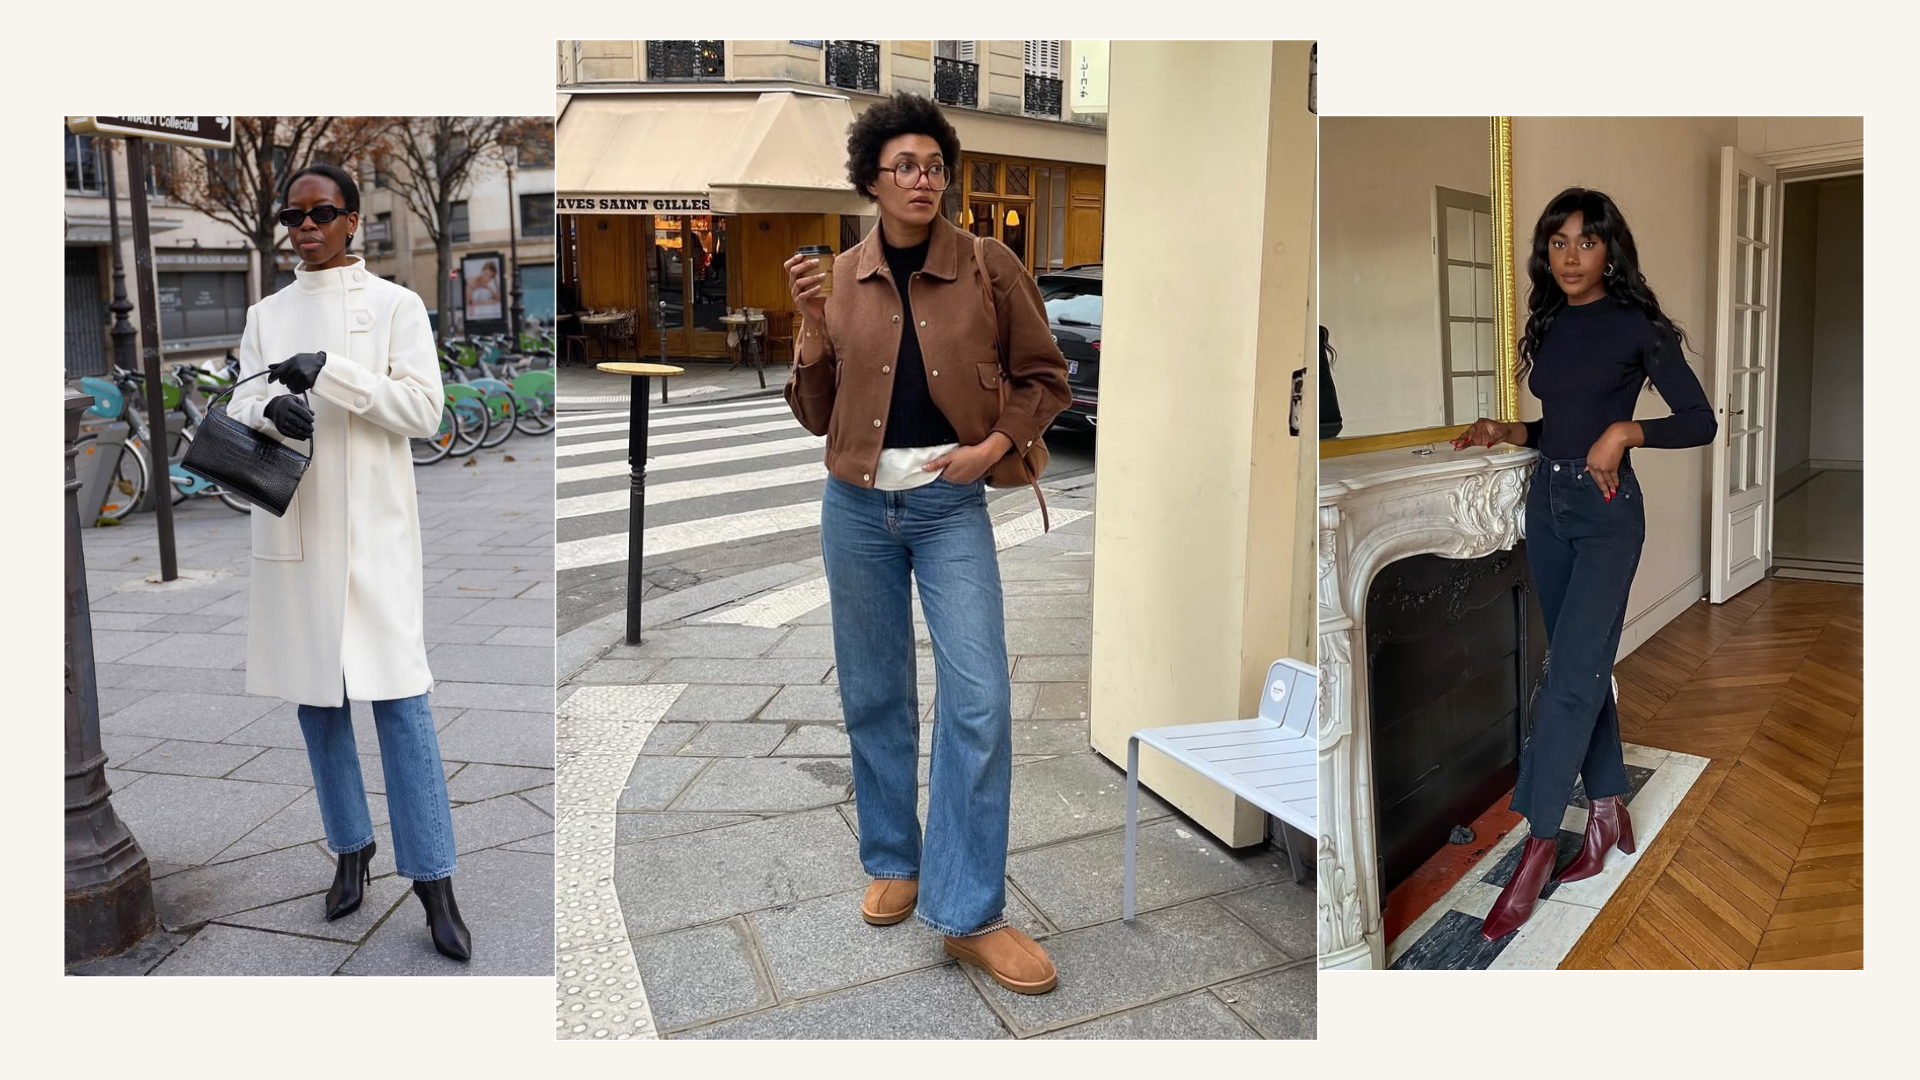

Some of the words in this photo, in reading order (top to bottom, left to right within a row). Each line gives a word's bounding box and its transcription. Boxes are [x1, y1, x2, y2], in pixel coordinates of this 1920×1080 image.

[556, 198, 596, 210] AVES
[600, 198, 649, 210] SAINT
[653, 199, 711, 210] GILLES
